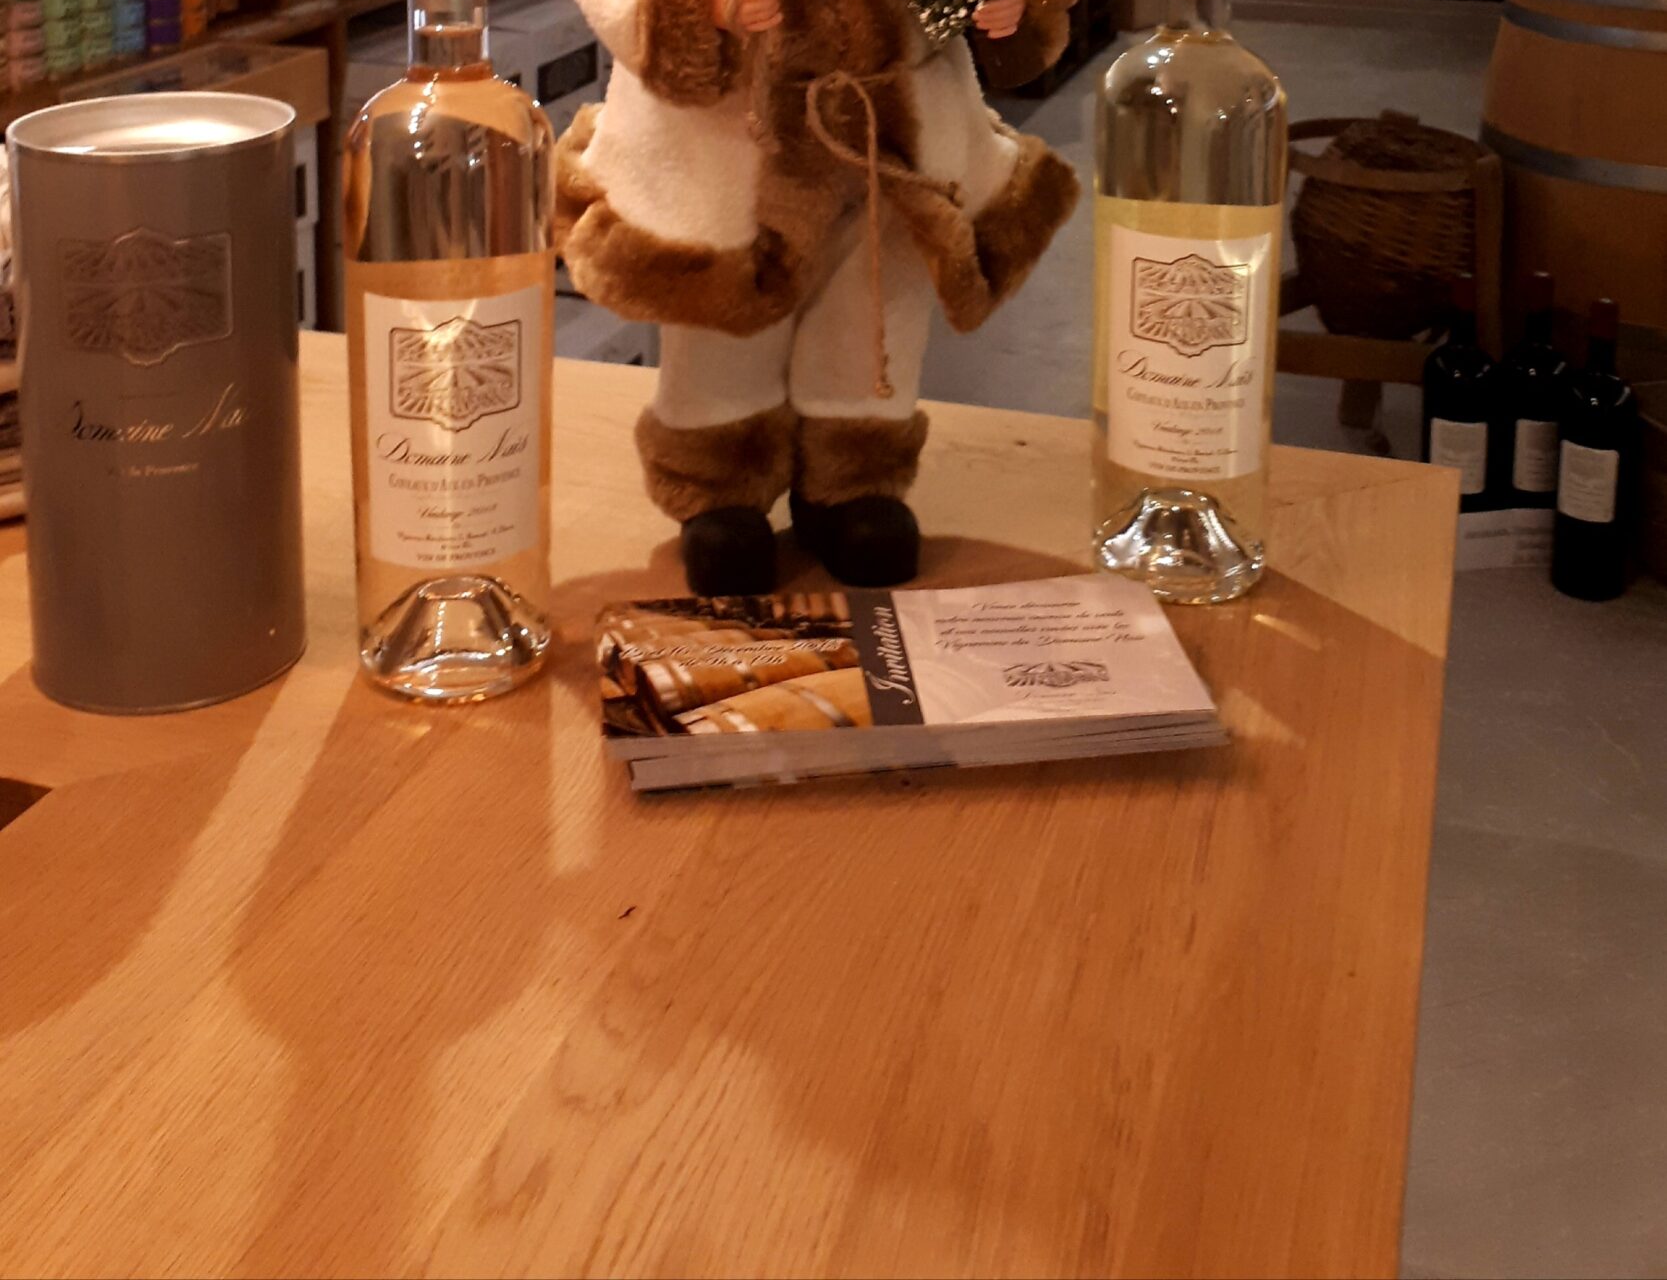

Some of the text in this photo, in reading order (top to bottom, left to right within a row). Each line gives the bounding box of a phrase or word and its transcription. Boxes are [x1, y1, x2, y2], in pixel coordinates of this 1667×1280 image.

[1117, 349, 1202, 387] Domaine
[376, 431, 471, 466] Domaine
[866, 606, 914, 705] Invitation
